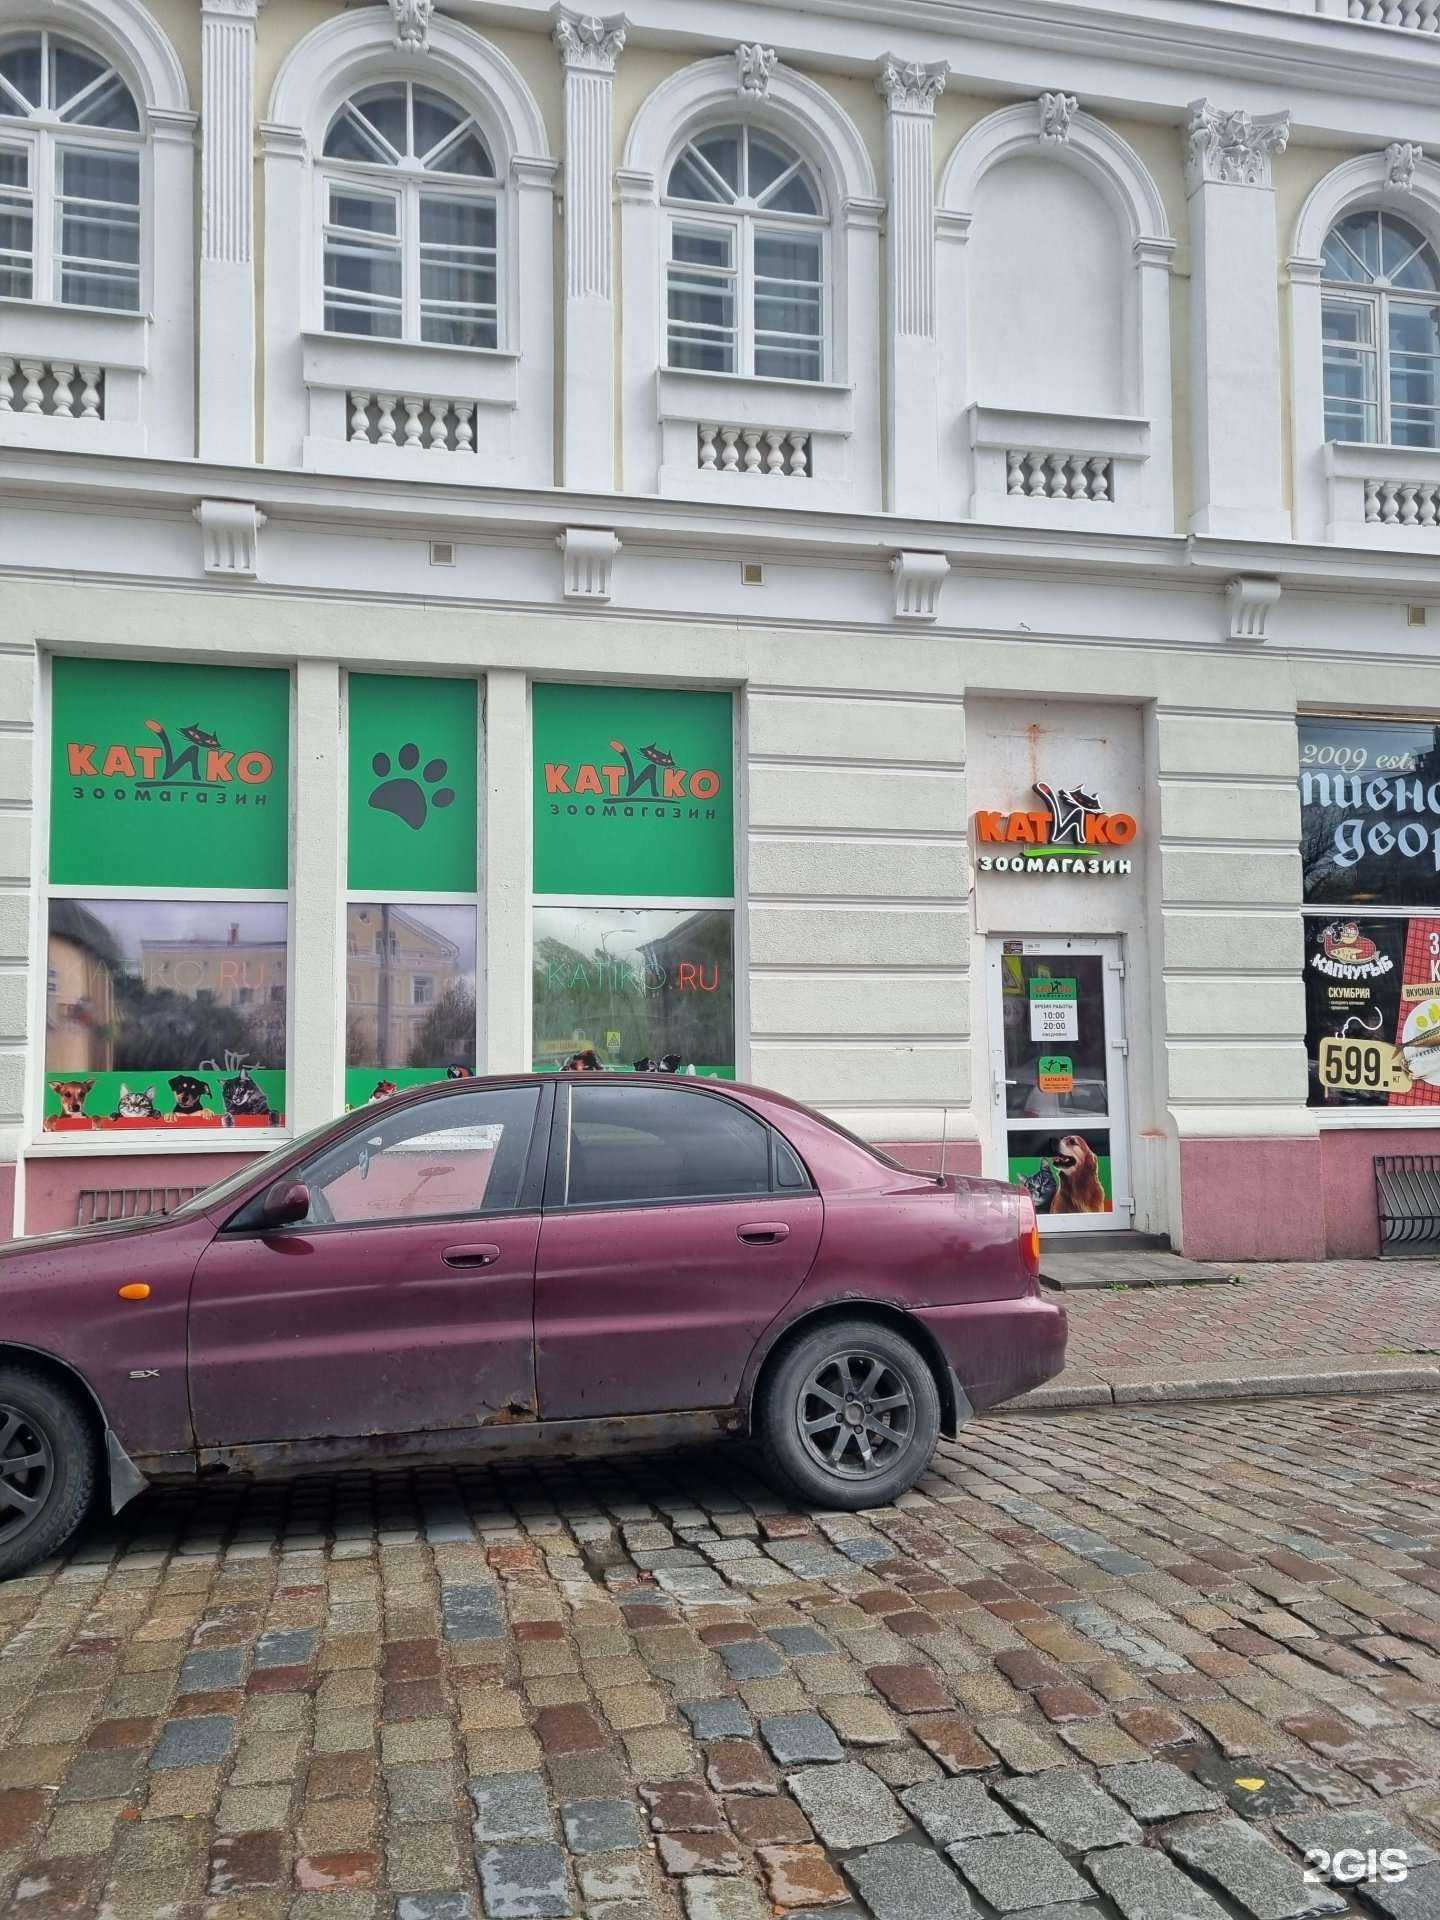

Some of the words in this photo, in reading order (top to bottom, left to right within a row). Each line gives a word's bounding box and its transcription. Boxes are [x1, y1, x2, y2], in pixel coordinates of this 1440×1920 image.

[67, 720, 273, 784] КАТИКО
[1301, 744, 1368, 773] 2009
[544, 740, 721, 799] КАТИКО
[975, 782, 1136, 845] КАТИКО
[979, 856, 1132, 874] ЗООМАГАЗИН
[1311, 953, 1394, 980] КАПЧУРЫБ
[1328, 987, 1370, 998] СКУМБРИЯ
[1406, 988, 1434, 998] ВКУСНАЯ
[1043, 1022, 1065, 1030] 20:00
[128, 1369, 160, 1379] SX
